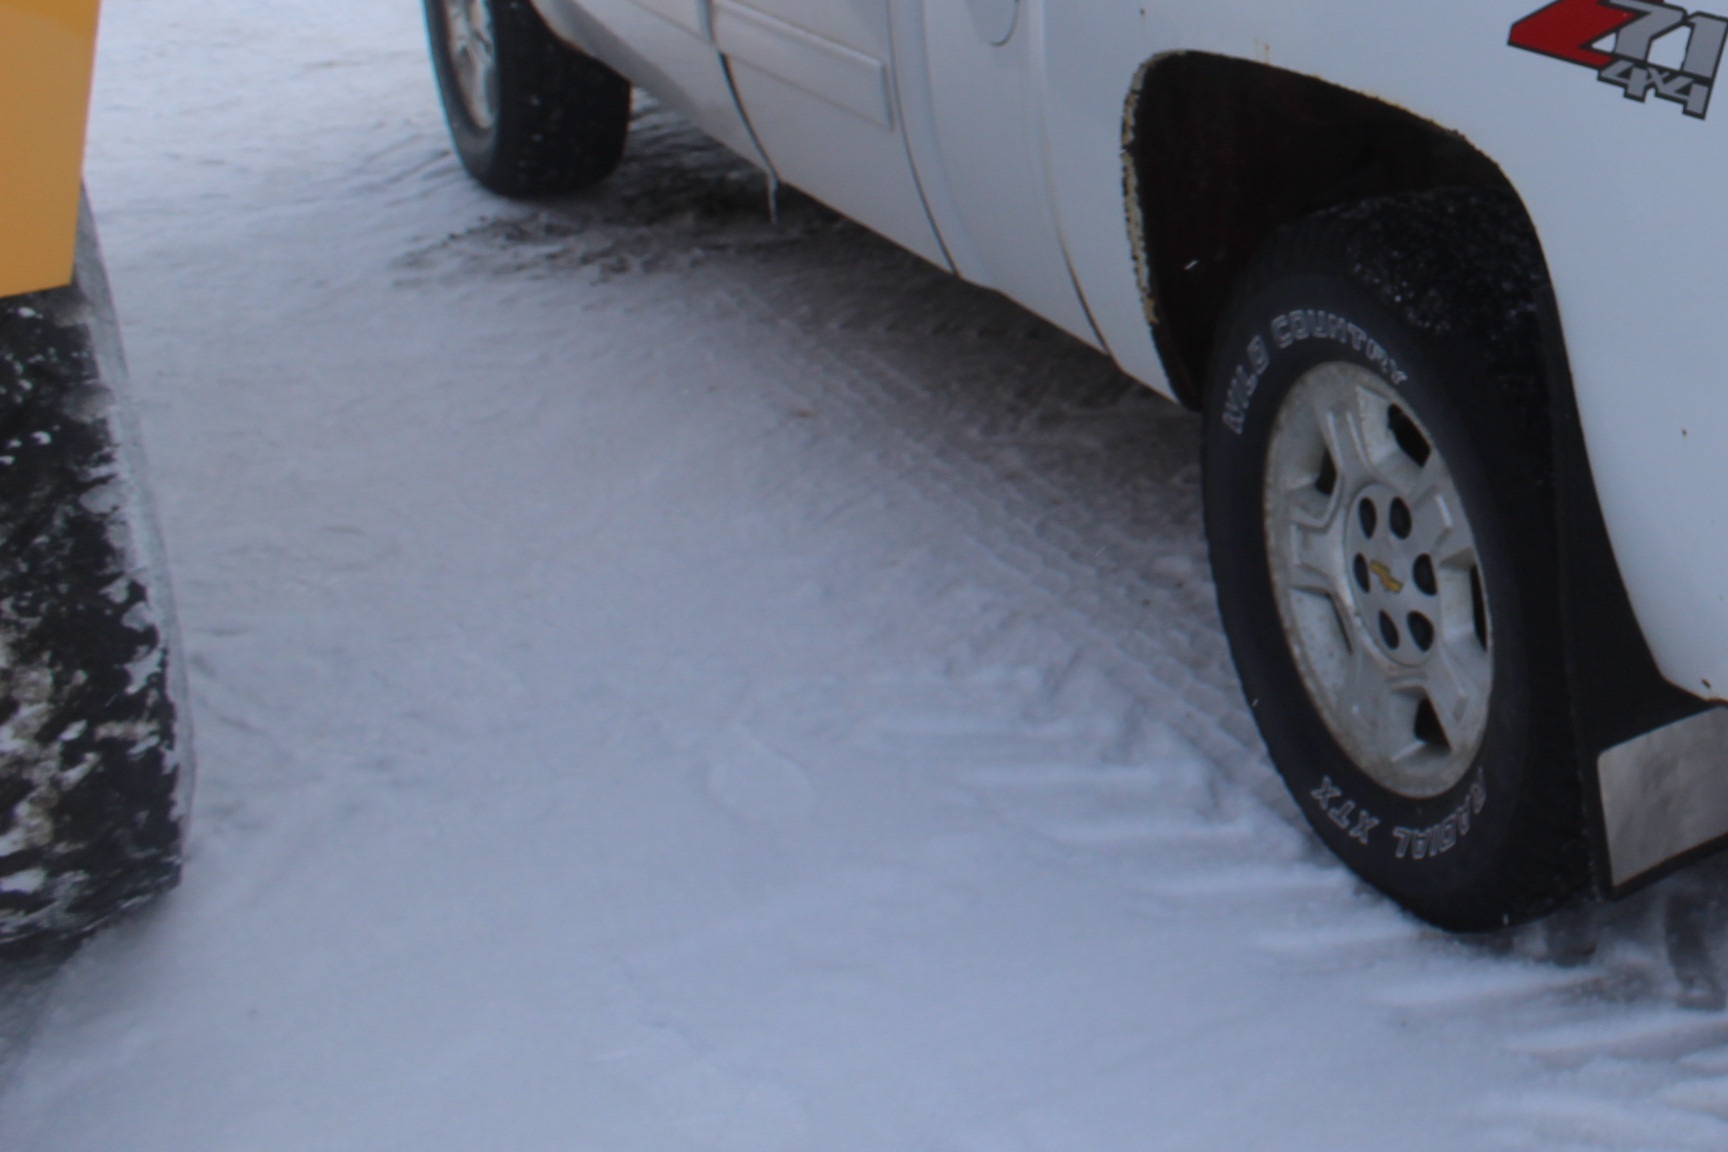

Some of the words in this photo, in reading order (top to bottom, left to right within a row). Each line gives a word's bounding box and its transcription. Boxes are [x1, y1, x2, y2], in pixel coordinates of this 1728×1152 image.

[1271, 309, 1408, 386] COUNTRY
[1310, 774, 1381, 845] XTX
[1392, 766, 1487, 860] RADIAL
